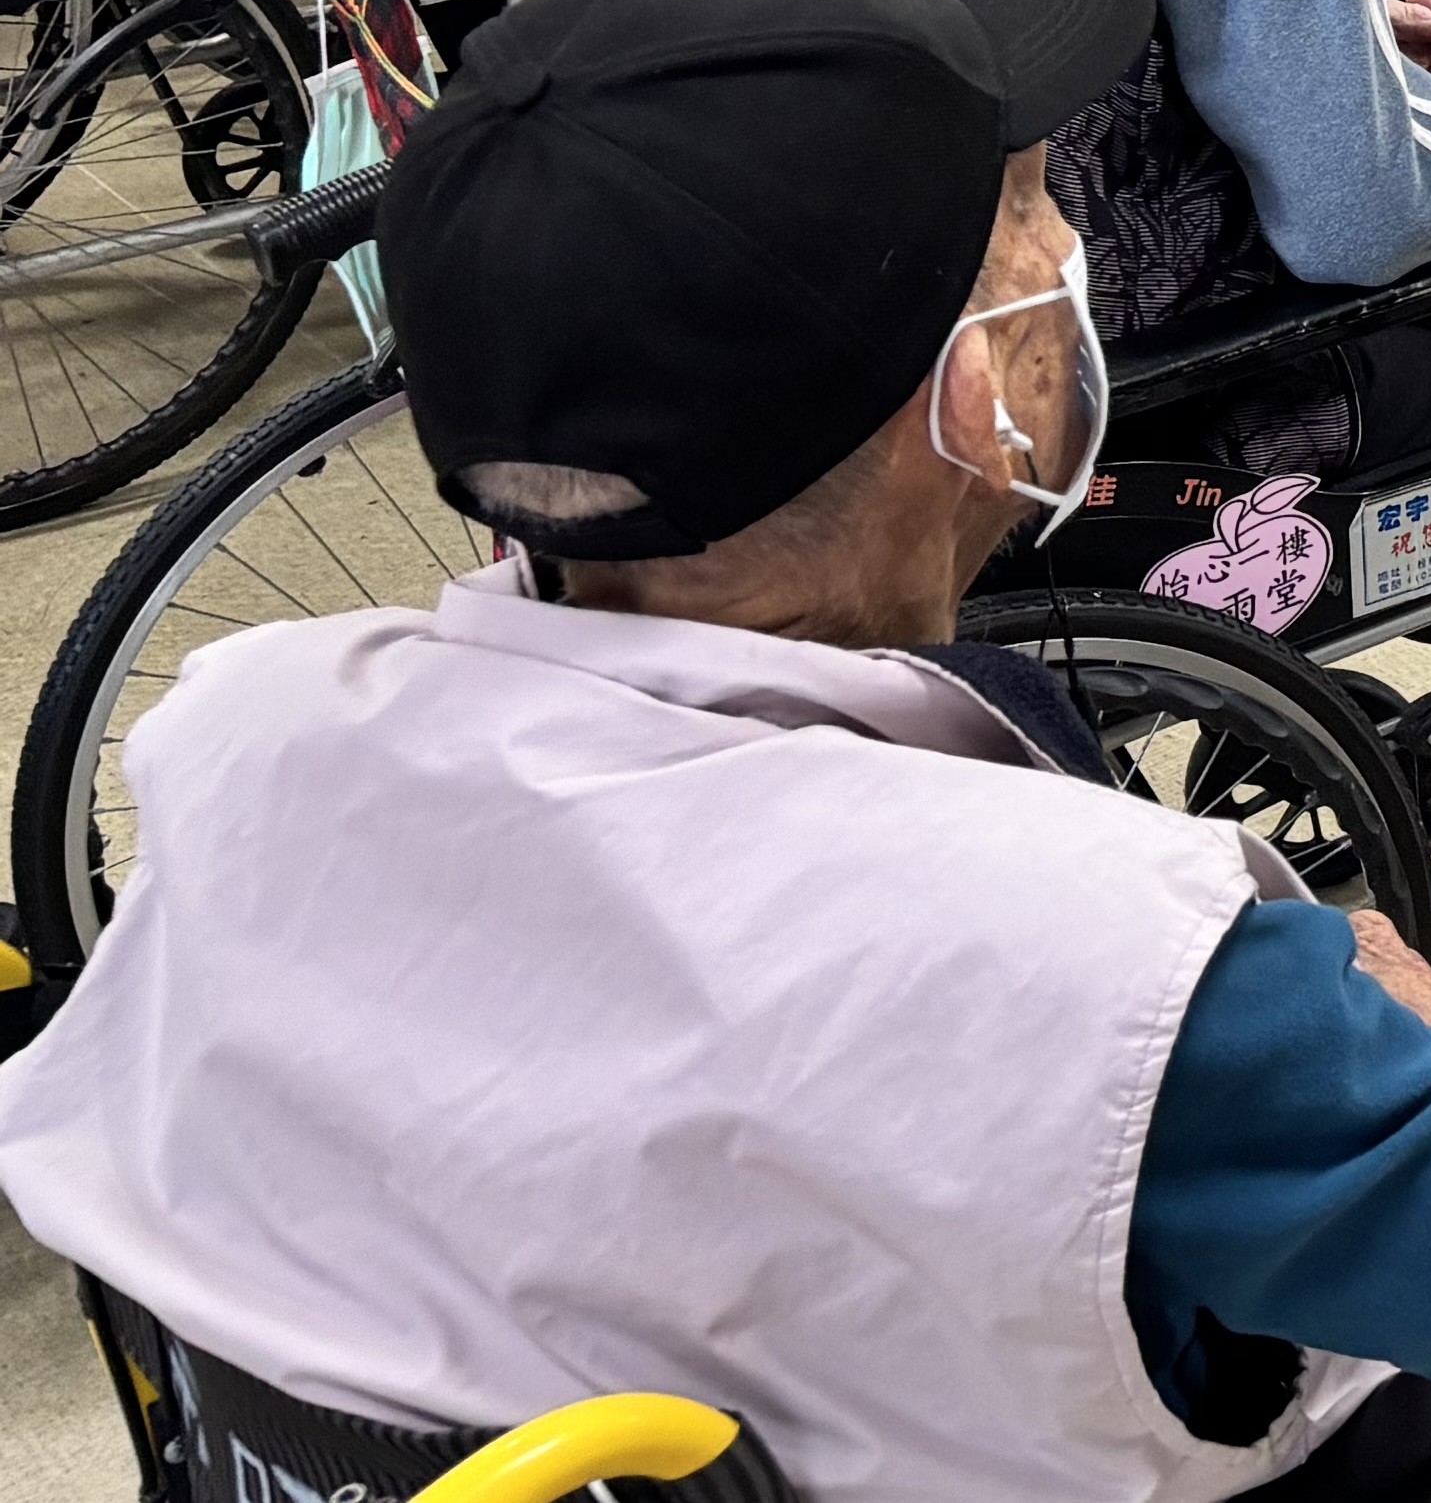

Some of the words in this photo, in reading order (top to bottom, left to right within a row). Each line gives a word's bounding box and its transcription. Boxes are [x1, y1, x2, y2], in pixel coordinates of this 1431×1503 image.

[1175, 478, 1222, 507] Jin
[1156, 525, 1314, 601] 怡心一樓
[1221, 568, 1307, 625] 雨堂
